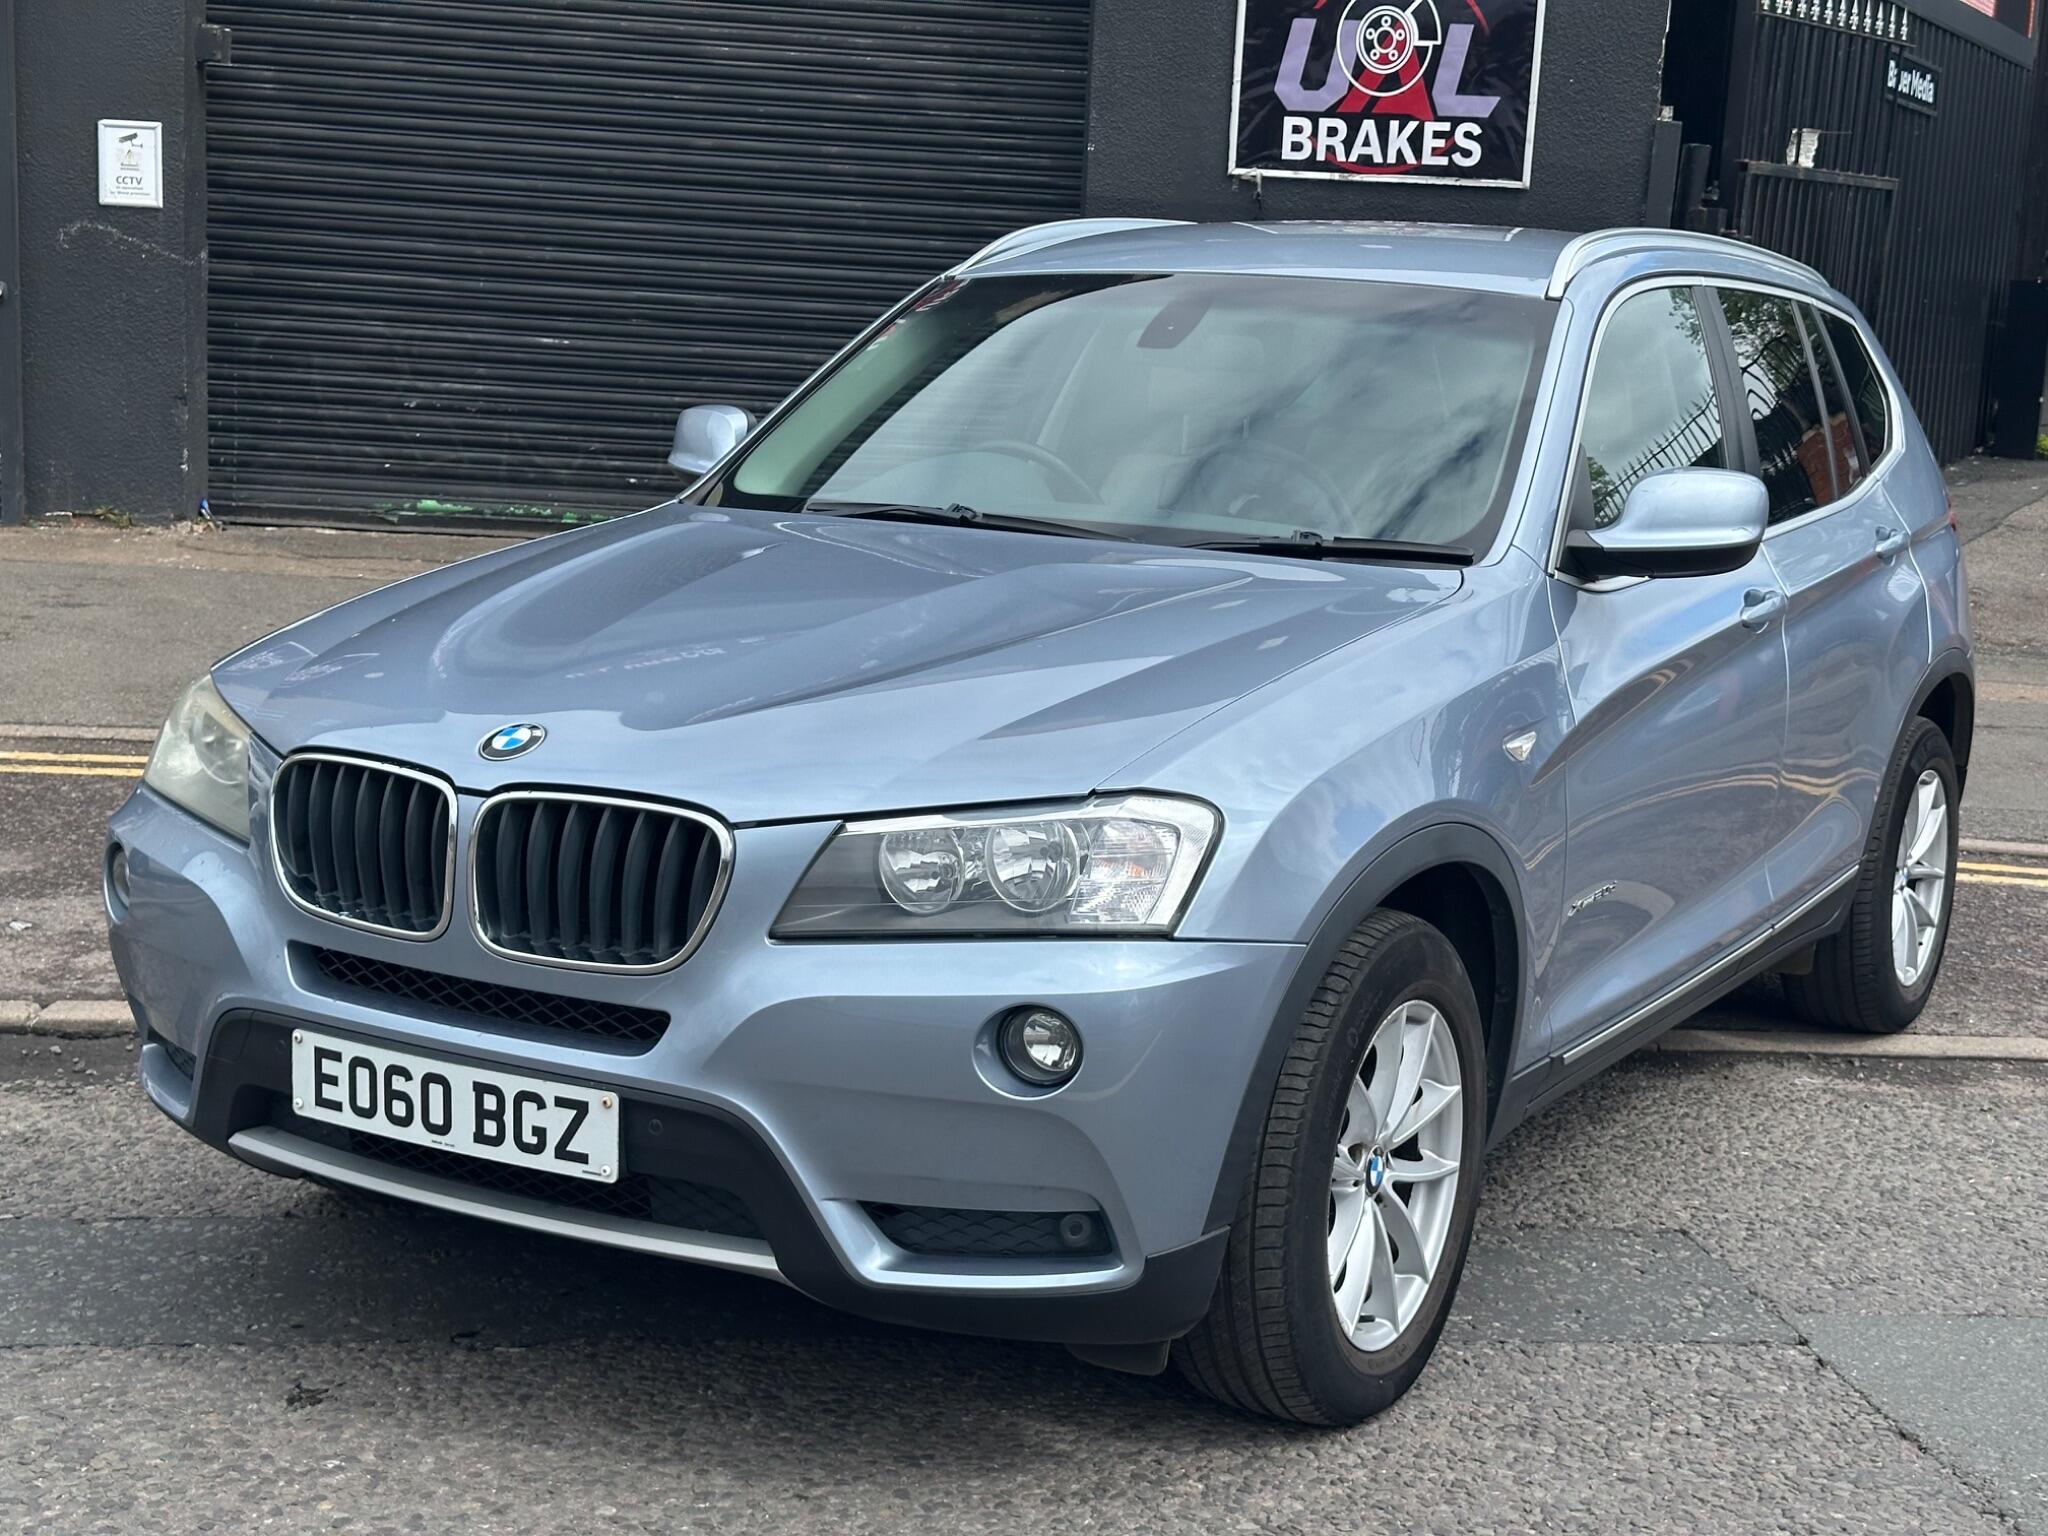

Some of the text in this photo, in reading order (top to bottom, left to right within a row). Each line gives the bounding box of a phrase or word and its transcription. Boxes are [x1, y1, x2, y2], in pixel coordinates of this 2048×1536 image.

[1910, 70, 1934, 103] Media
[1281, 115, 1482, 167] BRAKES
[116, 175, 143, 185] CCTV
[313, 1045, 590, 1165] EO60 BGZ
